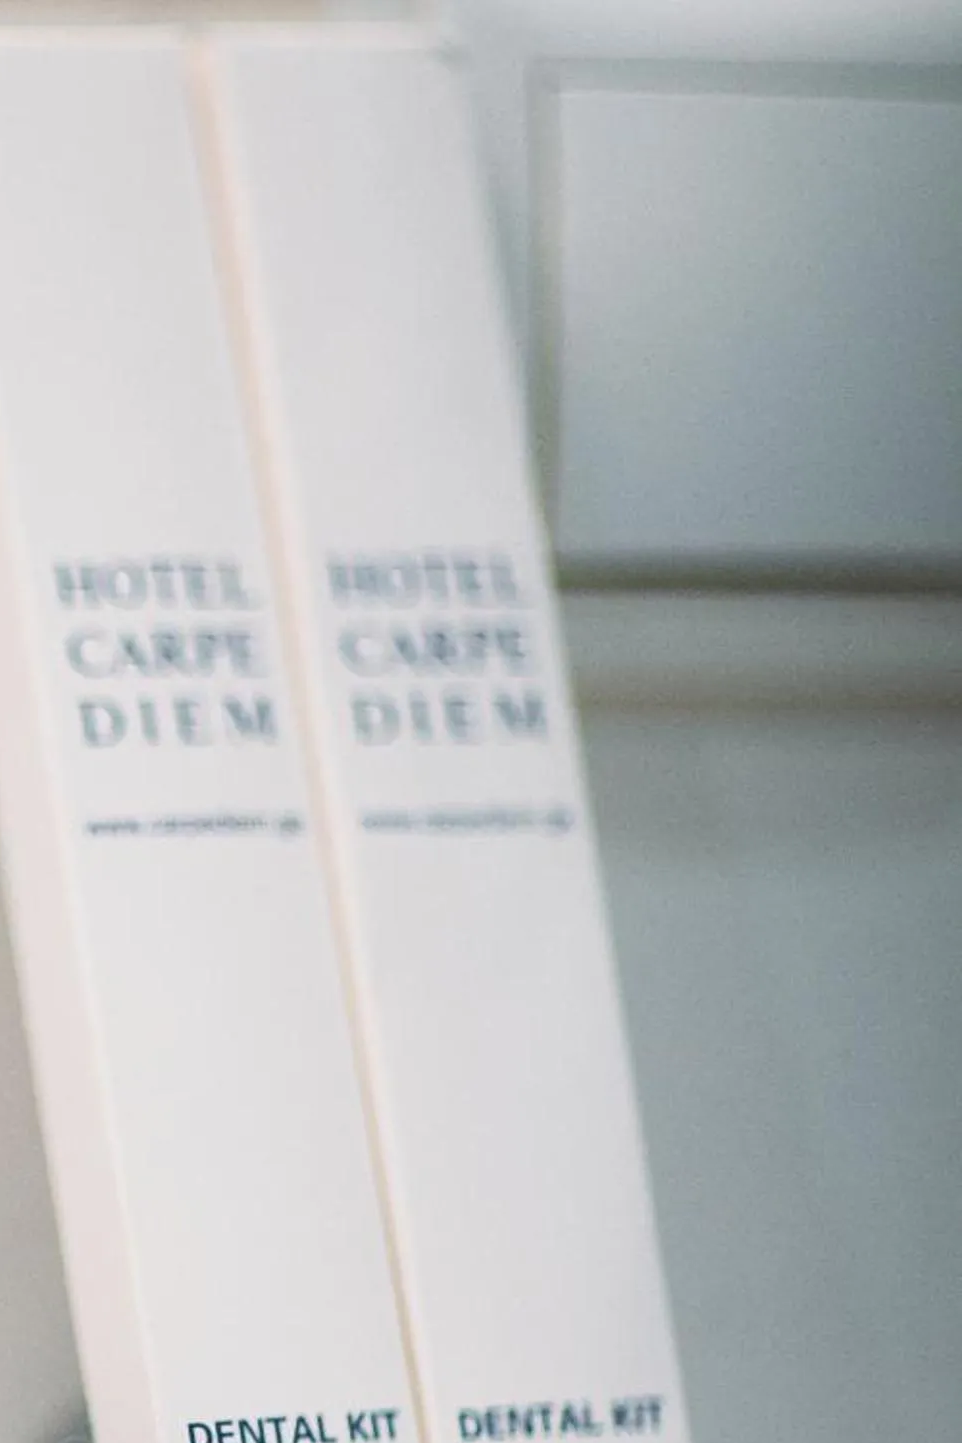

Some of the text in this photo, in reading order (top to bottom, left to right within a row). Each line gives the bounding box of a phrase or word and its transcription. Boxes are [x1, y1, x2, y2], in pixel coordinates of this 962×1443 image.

[78, 694, 278, 747] DIEM
[352, 690, 548, 744] DIEM
[346, 1408, 399, 1443] KIT
[458, 1396, 662, 1442] DENTAL KIT
